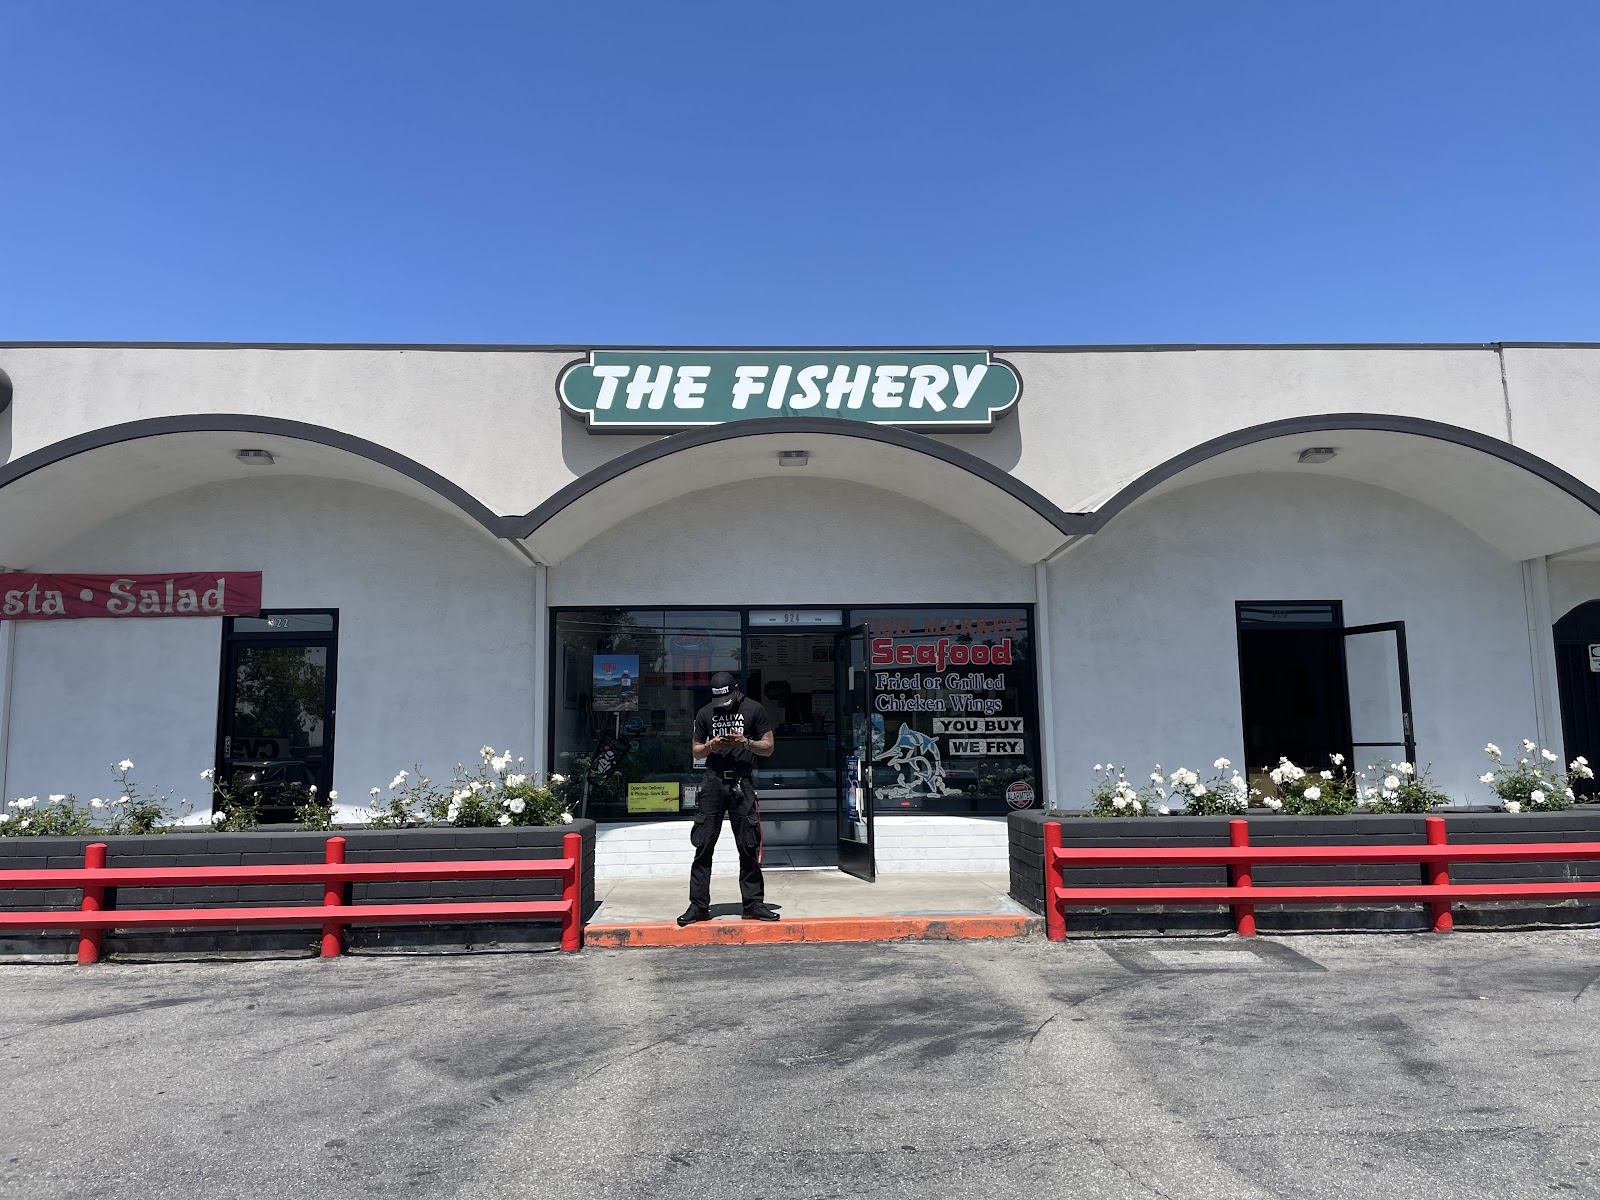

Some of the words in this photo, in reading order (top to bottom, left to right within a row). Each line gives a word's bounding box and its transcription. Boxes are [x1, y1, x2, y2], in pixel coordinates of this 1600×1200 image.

[592, 365, 711, 410] THE
[731, 364, 988, 412] FISHERY
[106, 577, 226, 614] Salad
[923, 616, 1021, 634] MARKET
[871, 638, 1012, 672] Seafood
[875, 672, 921, 690] Fried
[923, 677, 941, 690] or
[945, 673, 1005, 690] Grilled
[875, 693, 946, 711] Chicken
[950, 694, 1002, 715] Wings
[712, 714, 744, 722] CALIVA
[940, 720, 980, 732] YOU
[985, 720, 1022, 732] BUY
[952, 741, 980, 753] WE
[986, 741, 1018, 753] FRY
